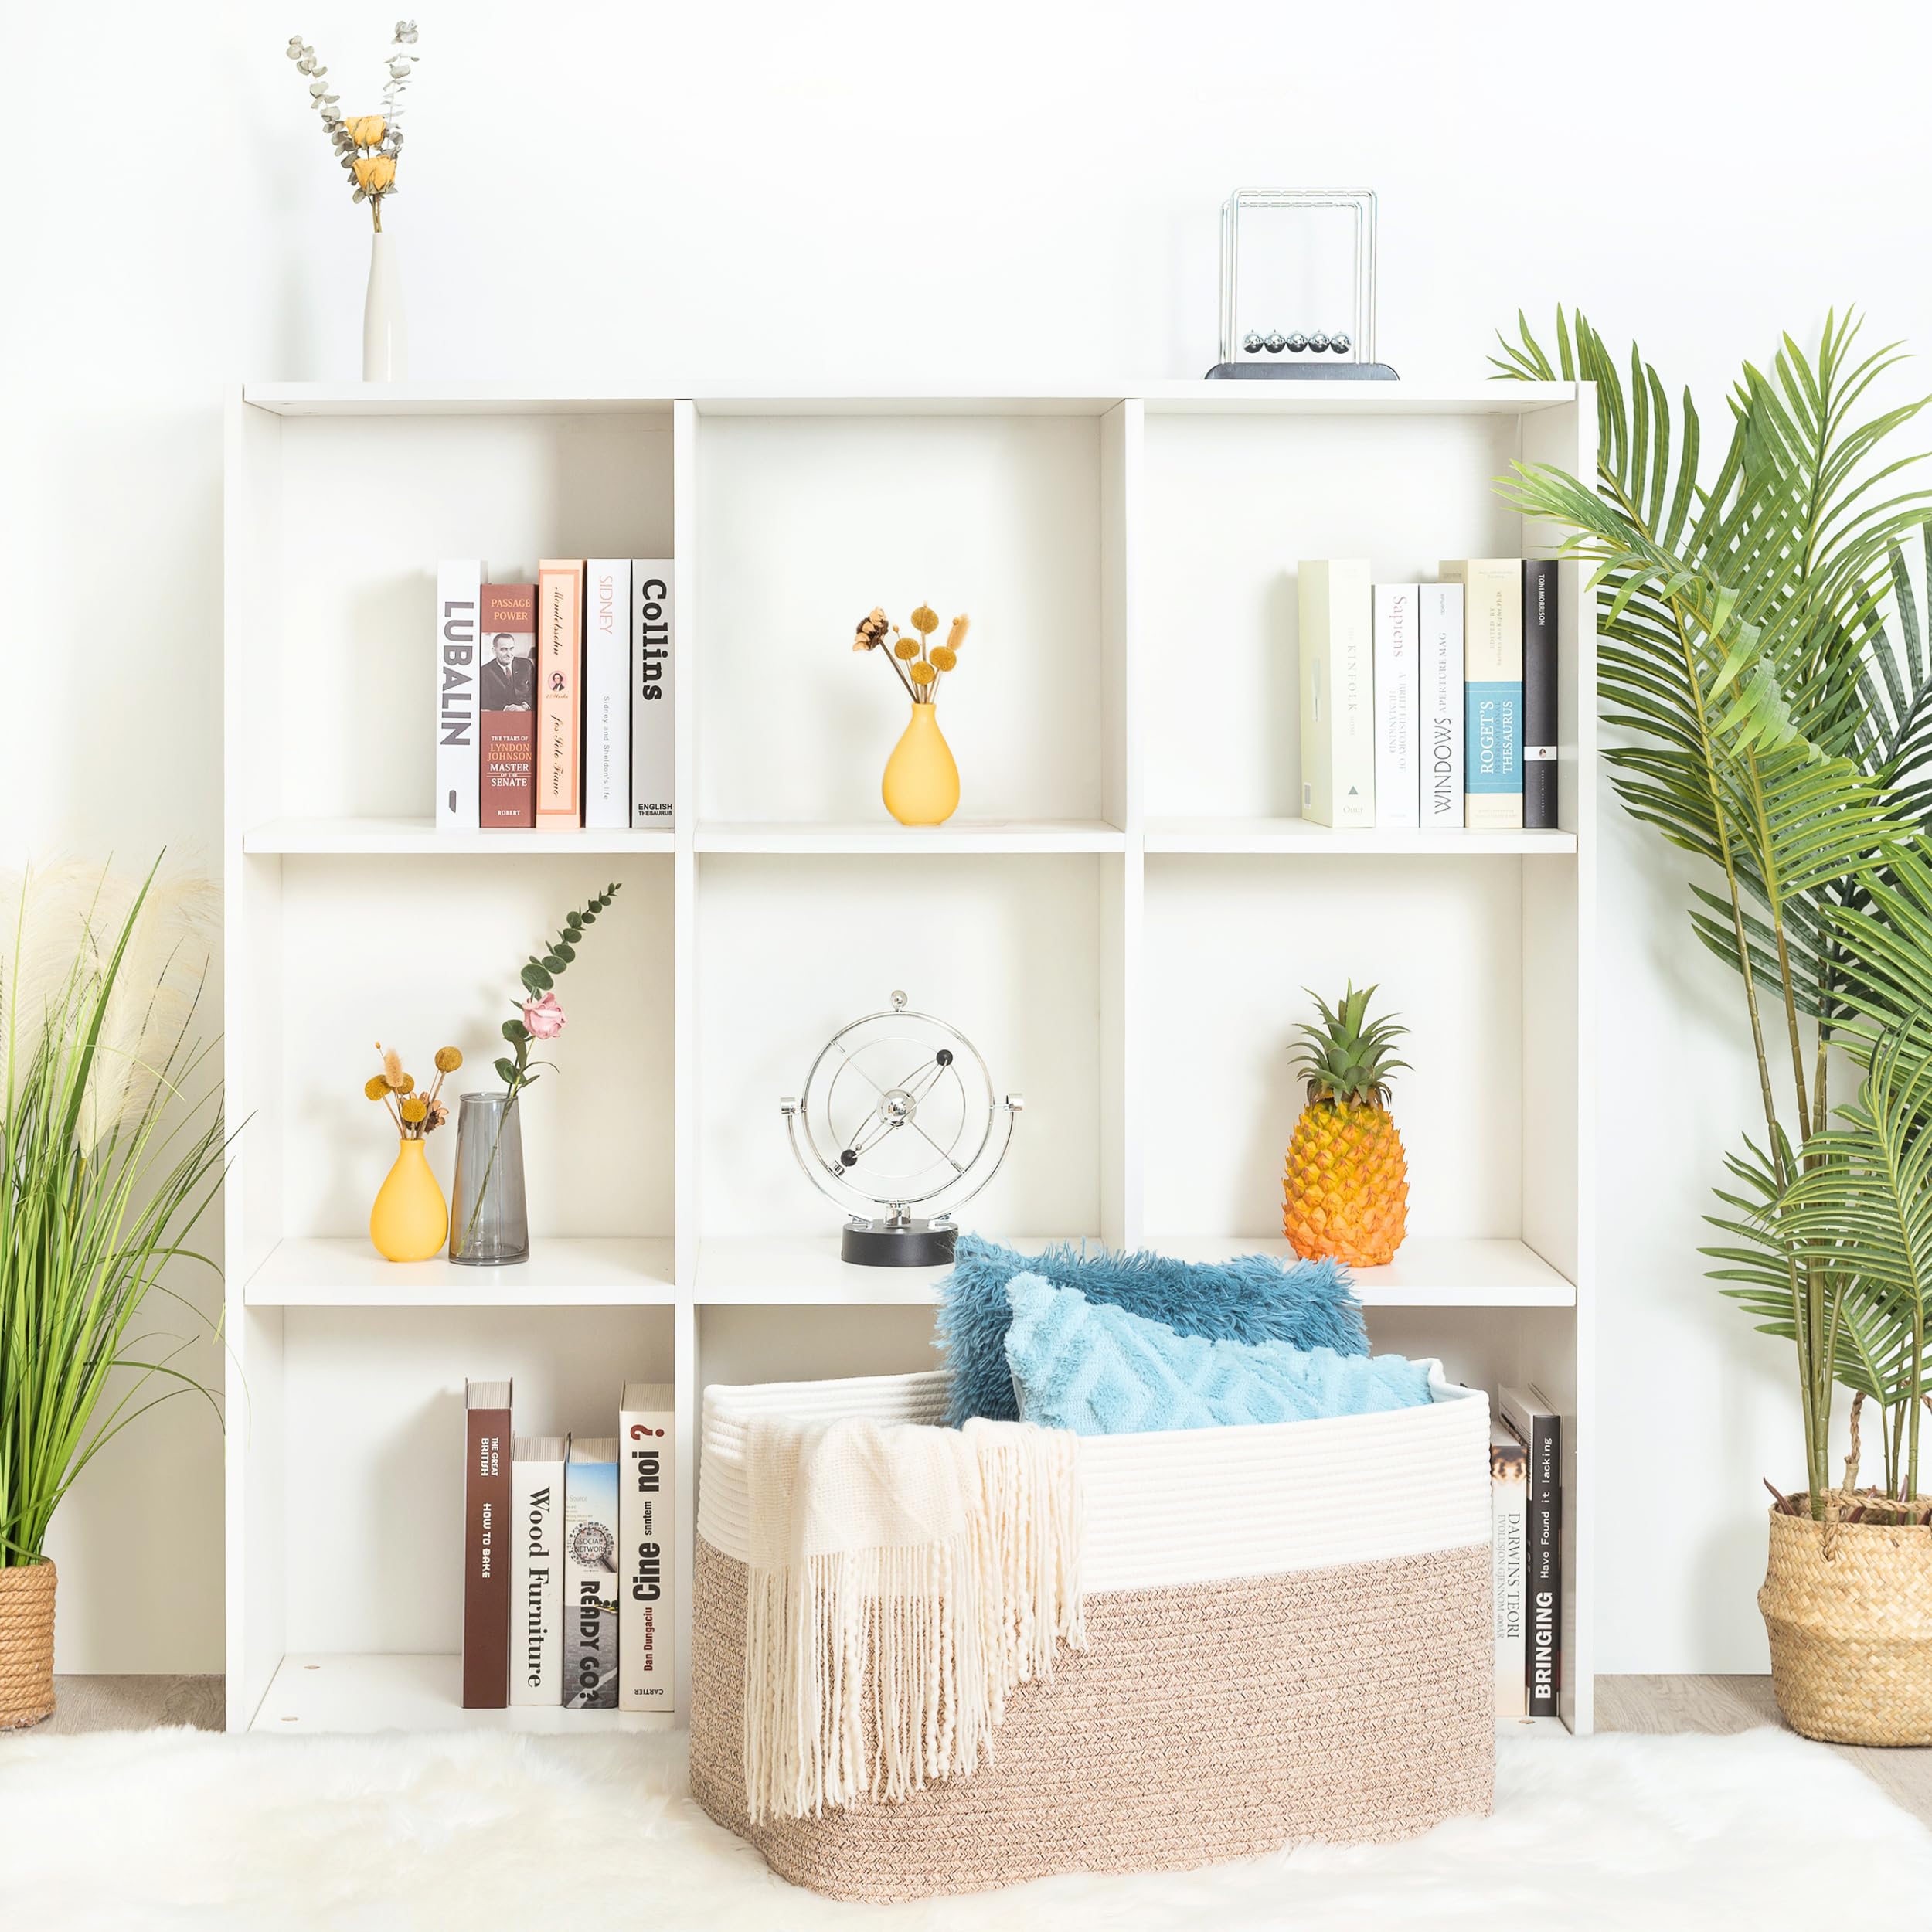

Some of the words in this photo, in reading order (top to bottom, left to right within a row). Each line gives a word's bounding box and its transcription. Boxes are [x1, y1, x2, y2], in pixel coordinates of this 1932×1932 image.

[491, 599, 531, 608] PASSAGE
[493, 612, 528, 621] POWER
[599, 576, 613, 634] SIDNEY
[642, 579, 668, 701] Collins
[1389, 596, 1407, 657] Sapiens
[440, 601, 474, 746] LUBALIN
[1347, 645, 1358, 712] KINFOLK
[487, 752, 532, 761] JOHNSON
[490, 743, 529, 752] LYNDON
[1480, 701, 1494, 774] ROGET'S
[1502, 701, 1513, 774] THESAURUS
[491, 778, 527, 787] SENATE
[1399, 757, 1406, 772] OF
[1434, 718, 1451, 814] WINDOWS
[481, 1437, 489, 1476] BRITISH
[632, 1451, 660, 1492] noi
[1542, 1437, 1552, 1483] lacking
[482, 1503, 492, 1529] HOW
[1541, 1492, 1550, 1503] it
[482, 1532, 491, 1546] TO
[528, 1485, 550, 1557] Wood
[1496, 1515, 1505, 1565] EVOLUSJON
[1540, 1512, 1550, 1545] Found
[482, 1548, 491, 1578] BAKE
[632, 1542, 661, 1601] Cine
[1508, 1513, 1520, 1587] DARWINS
[1540, 1551, 1549, 1578] Have
[1496, 1568, 1505, 1611] GJENNOM
[527, 1566, 549, 1688] Furniture
[580, 1581, 600, 1651] READY
[643, 1607, 655, 1651] Dungaciu
[1507, 1591, 1520, 1638] TEORI
[643, 1653, 653, 1671] Dan
[1535, 1592, 1553, 1698] BRINGING
[580, 1656, 600, 1700] GO?
